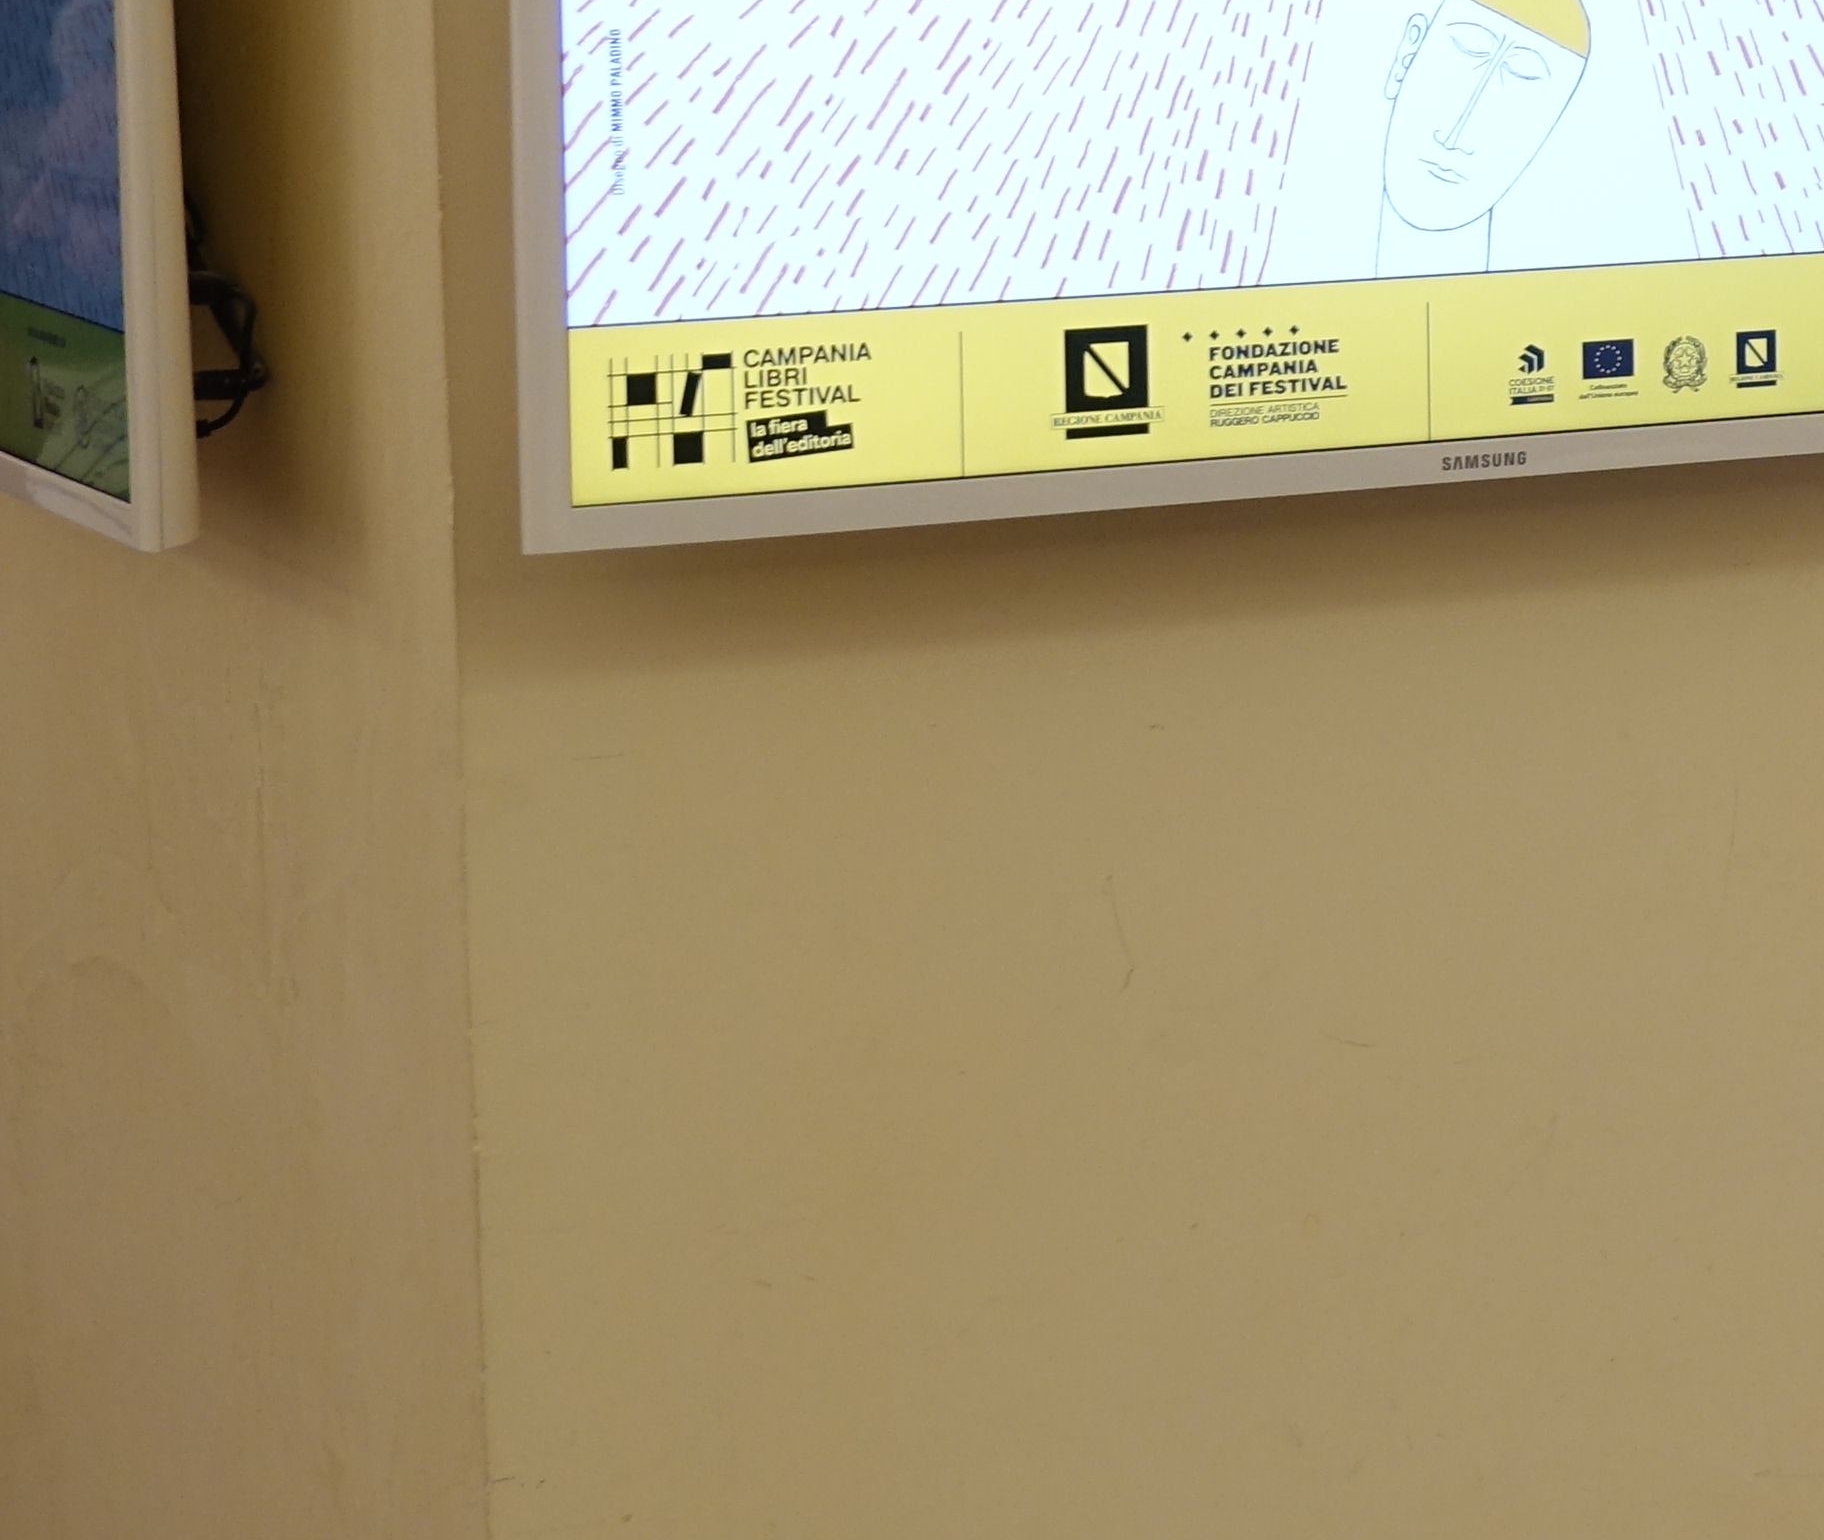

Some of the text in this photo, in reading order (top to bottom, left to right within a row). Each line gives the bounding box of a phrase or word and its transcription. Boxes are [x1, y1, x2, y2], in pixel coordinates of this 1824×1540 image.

[609, 28, 624, 85] PALADINO
[609, 90, 624, 131] MIMMO
[743, 342, 872, 369] CAMPANIA
[1210, 339, 1340, 361] FONDAZIONE
[745, 367, 808, 389] LIBRI
[1210, 360, 1318, 379] CAMPANIA
[745, 385, 861, 410] FESTIVAL
[1210, 376, 1347, 398] DEI FESTIVAL
[750, 417, 808, 438] la fiera
[1442, 451, 1527, 471] SAMSUNG
